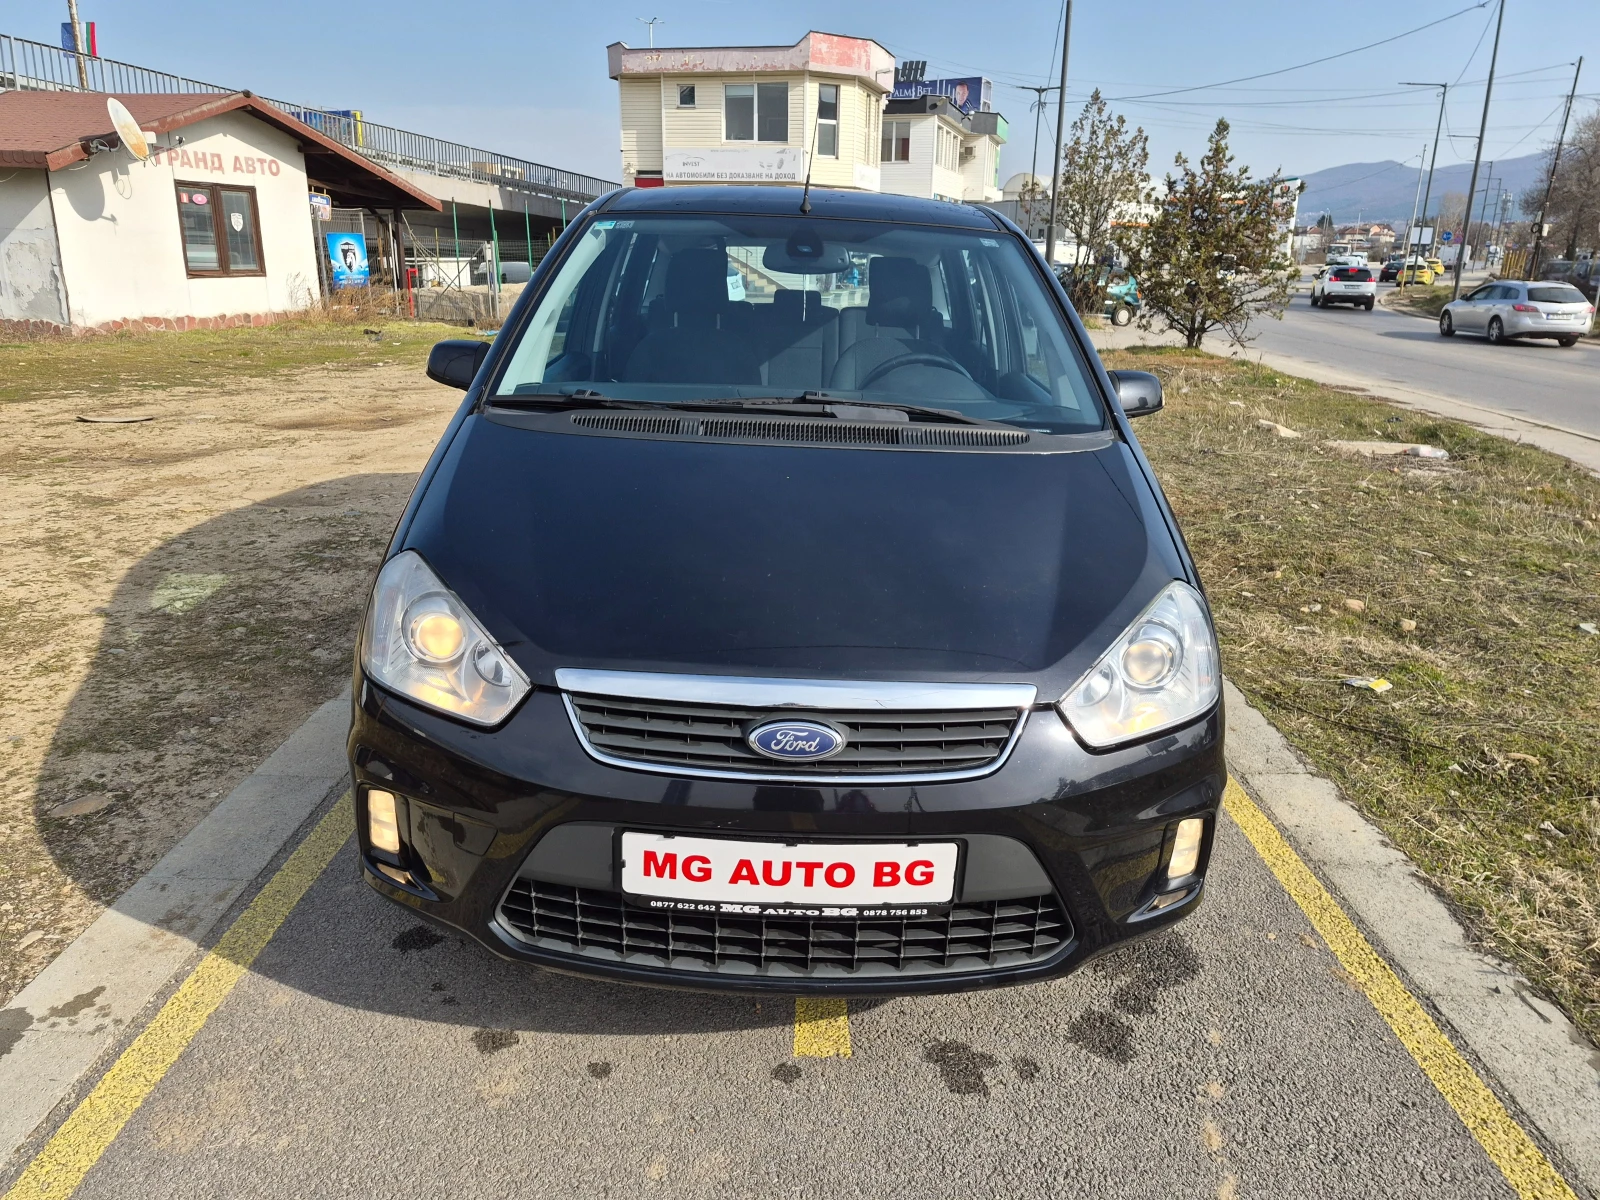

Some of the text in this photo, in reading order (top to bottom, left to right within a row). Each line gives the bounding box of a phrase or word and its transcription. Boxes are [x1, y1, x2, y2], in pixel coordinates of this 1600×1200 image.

[153, 146, 280, 177] ГРАНД АВТО
[675, 171, 715, 179] АВТОМОБИЛИ
[728, 171, 763, 180] ДОКАЗВАНЕ
[774, 172, 796, 180] ДОХОД
[770, 729, 821, 752] Ford
[643, 850, 935, 888] MG AUTO BG
[720, 903, 762, 914] MG
[821, 907, 860, 917] BG
